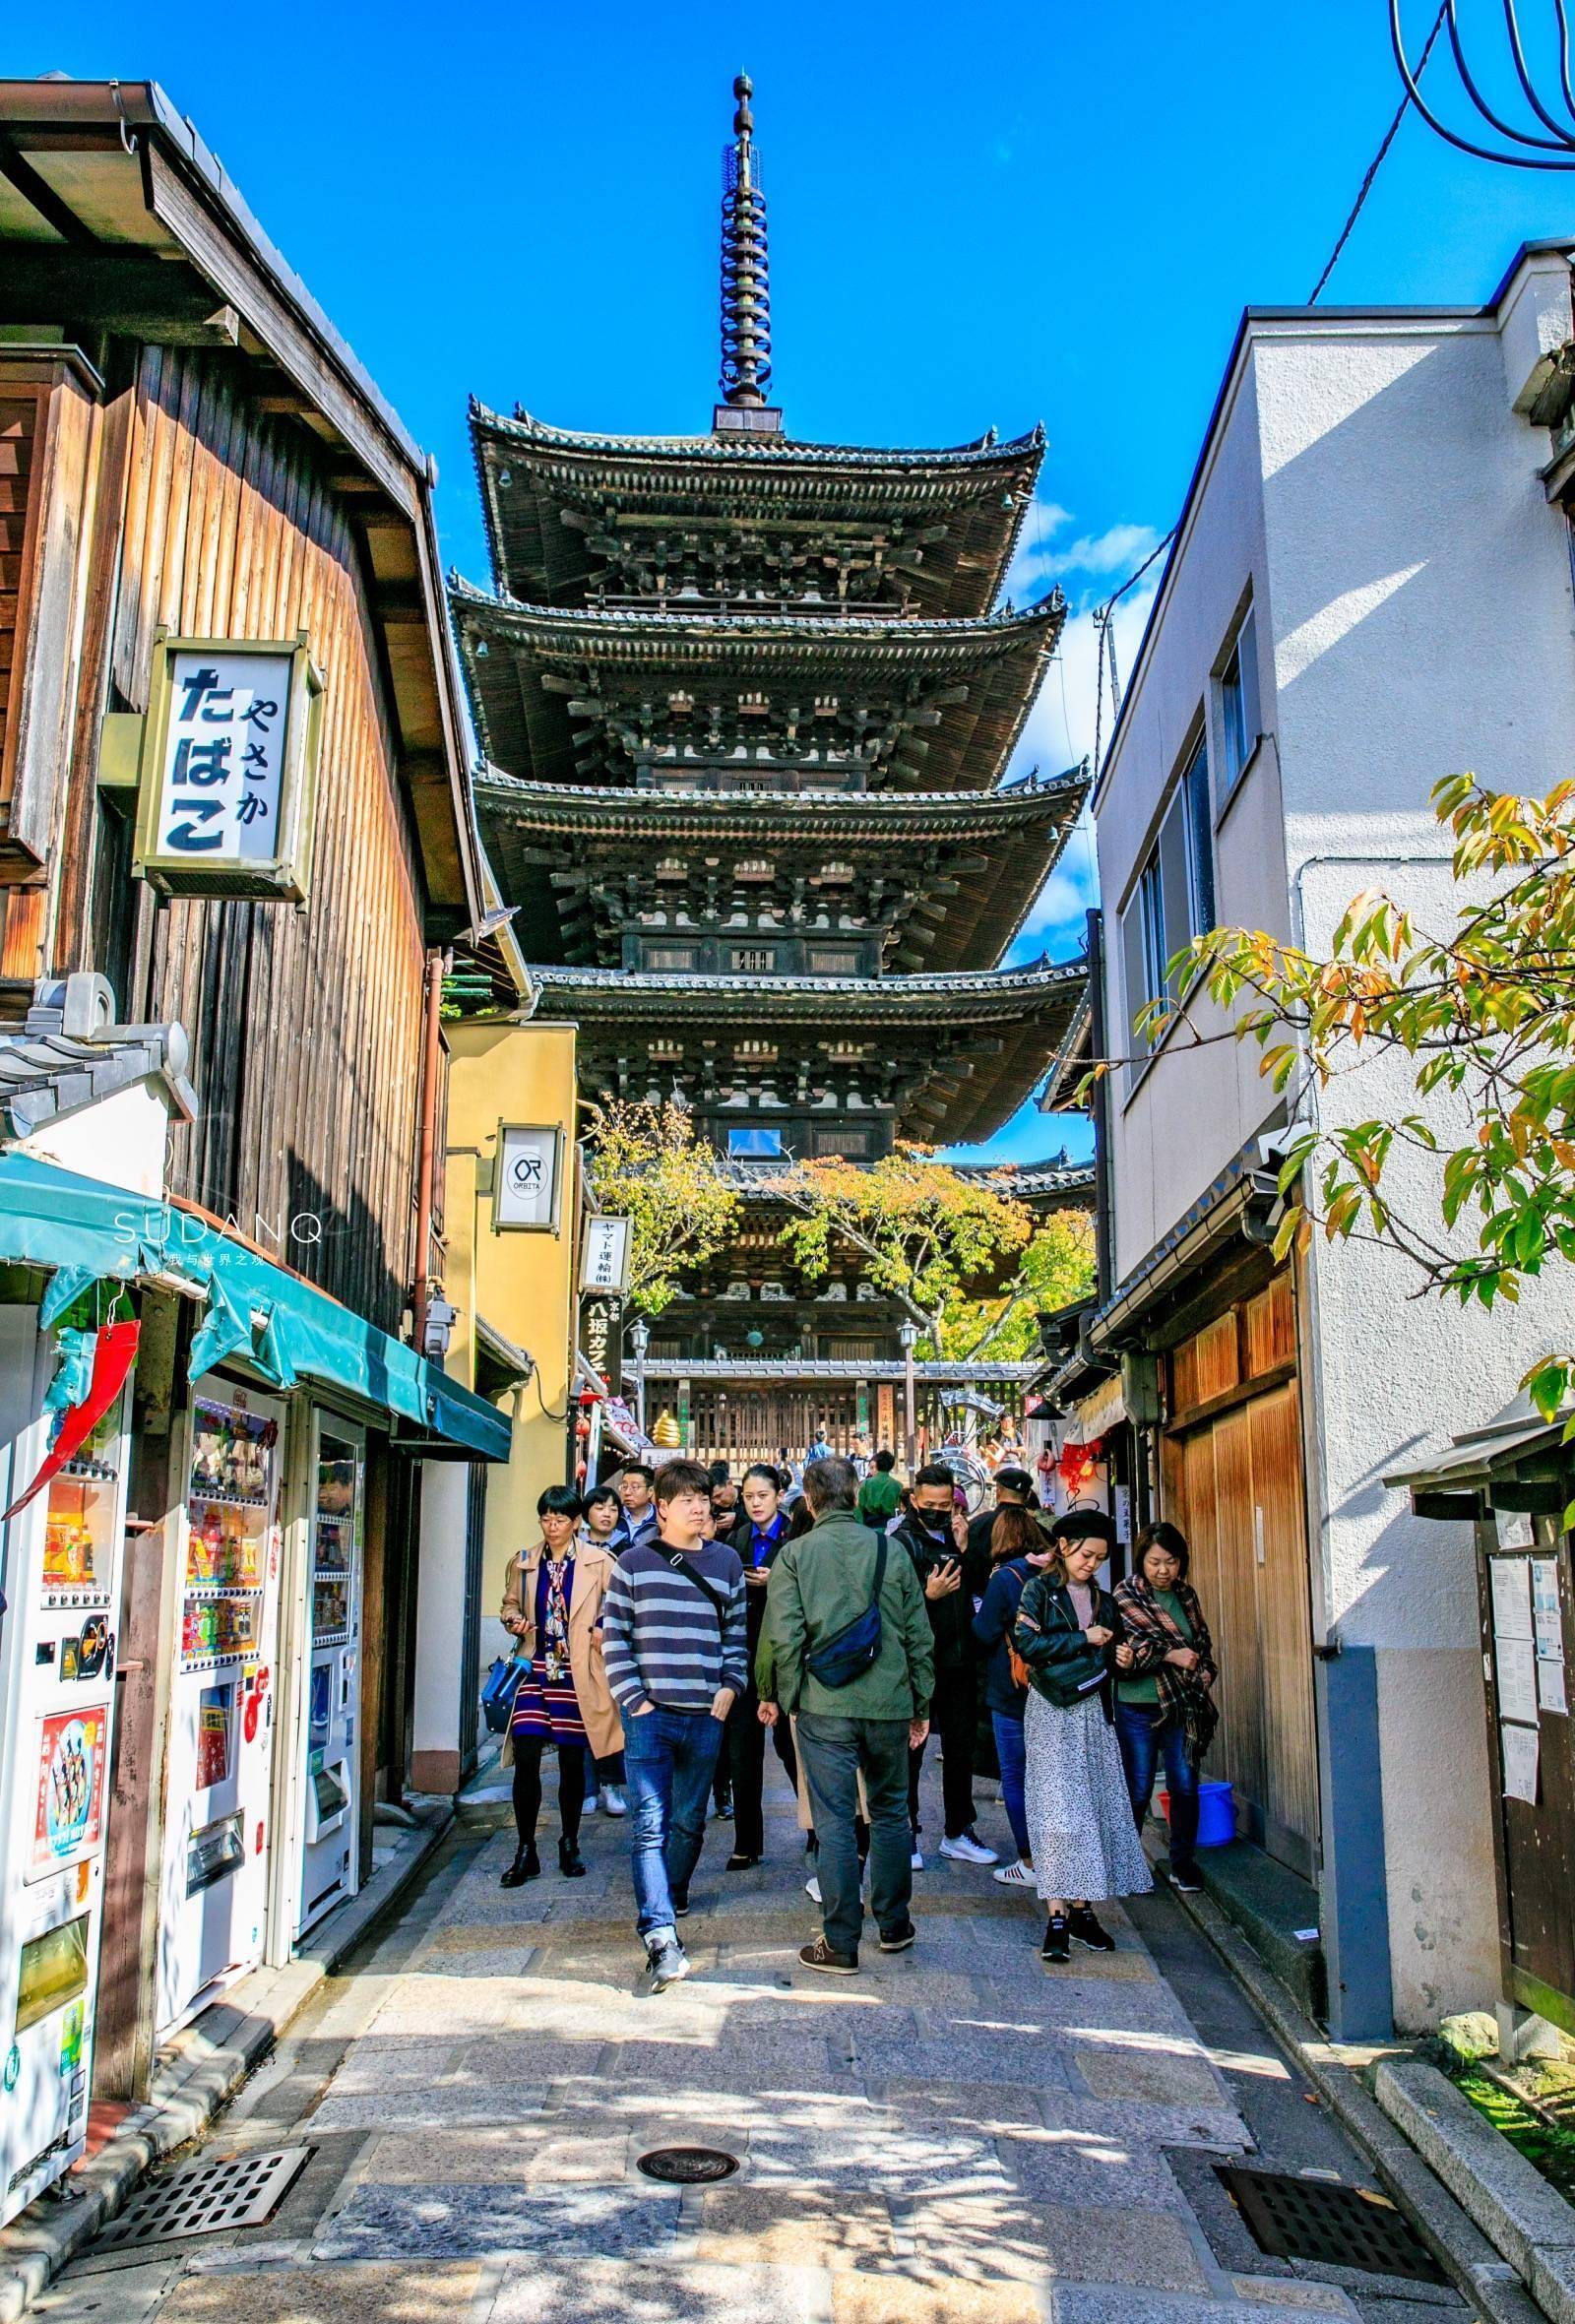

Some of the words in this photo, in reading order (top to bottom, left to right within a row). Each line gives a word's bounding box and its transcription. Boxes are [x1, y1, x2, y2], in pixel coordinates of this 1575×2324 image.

[165, 668, 235, 852] たばこ
[235, 699, 279, 826] やさか
[588, 1301, 608, 1371] 八坂カフェ
[609, 1301, 620, 1322] 京都
